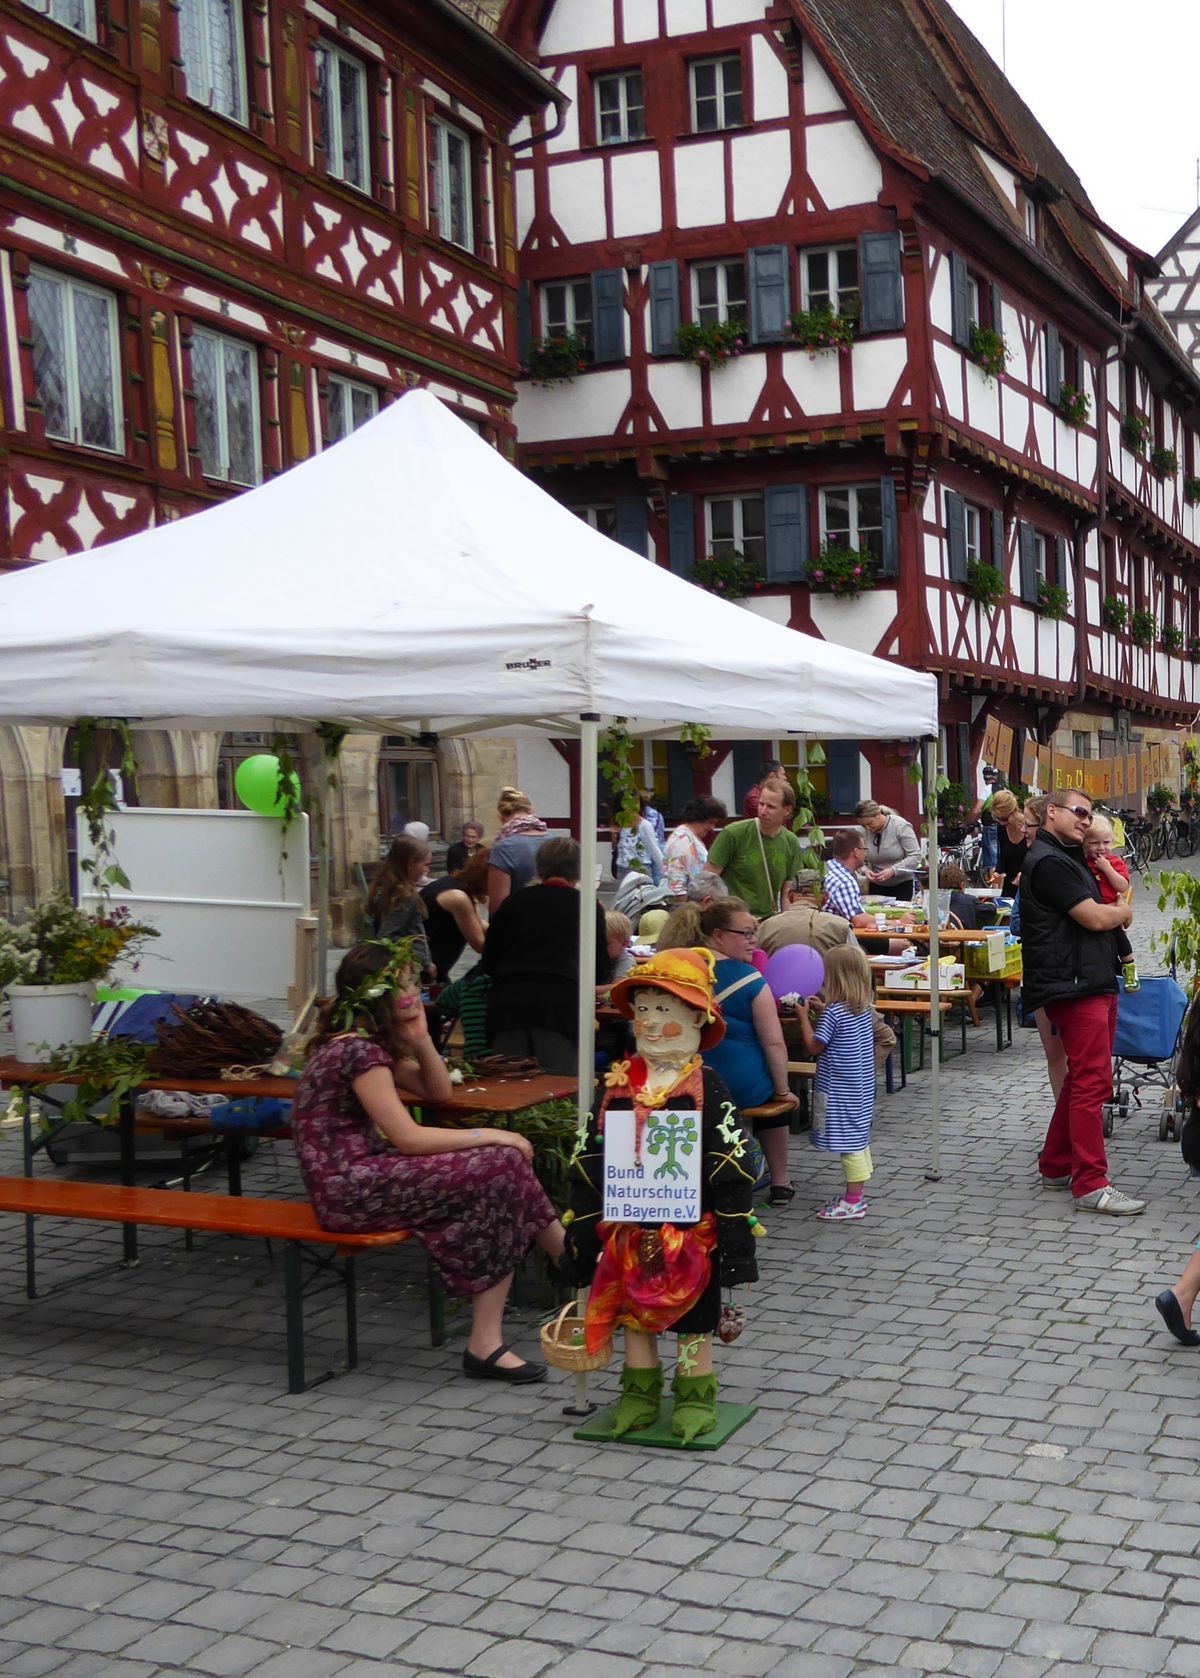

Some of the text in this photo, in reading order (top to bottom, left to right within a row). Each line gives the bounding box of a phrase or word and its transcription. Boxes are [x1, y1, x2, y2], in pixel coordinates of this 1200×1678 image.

[607, 1165, 645, 1179] Bund
[607, 1184, 697, 1199] Naturschutz
[606, 1203, 697, 1220] in Bayern e.V.
